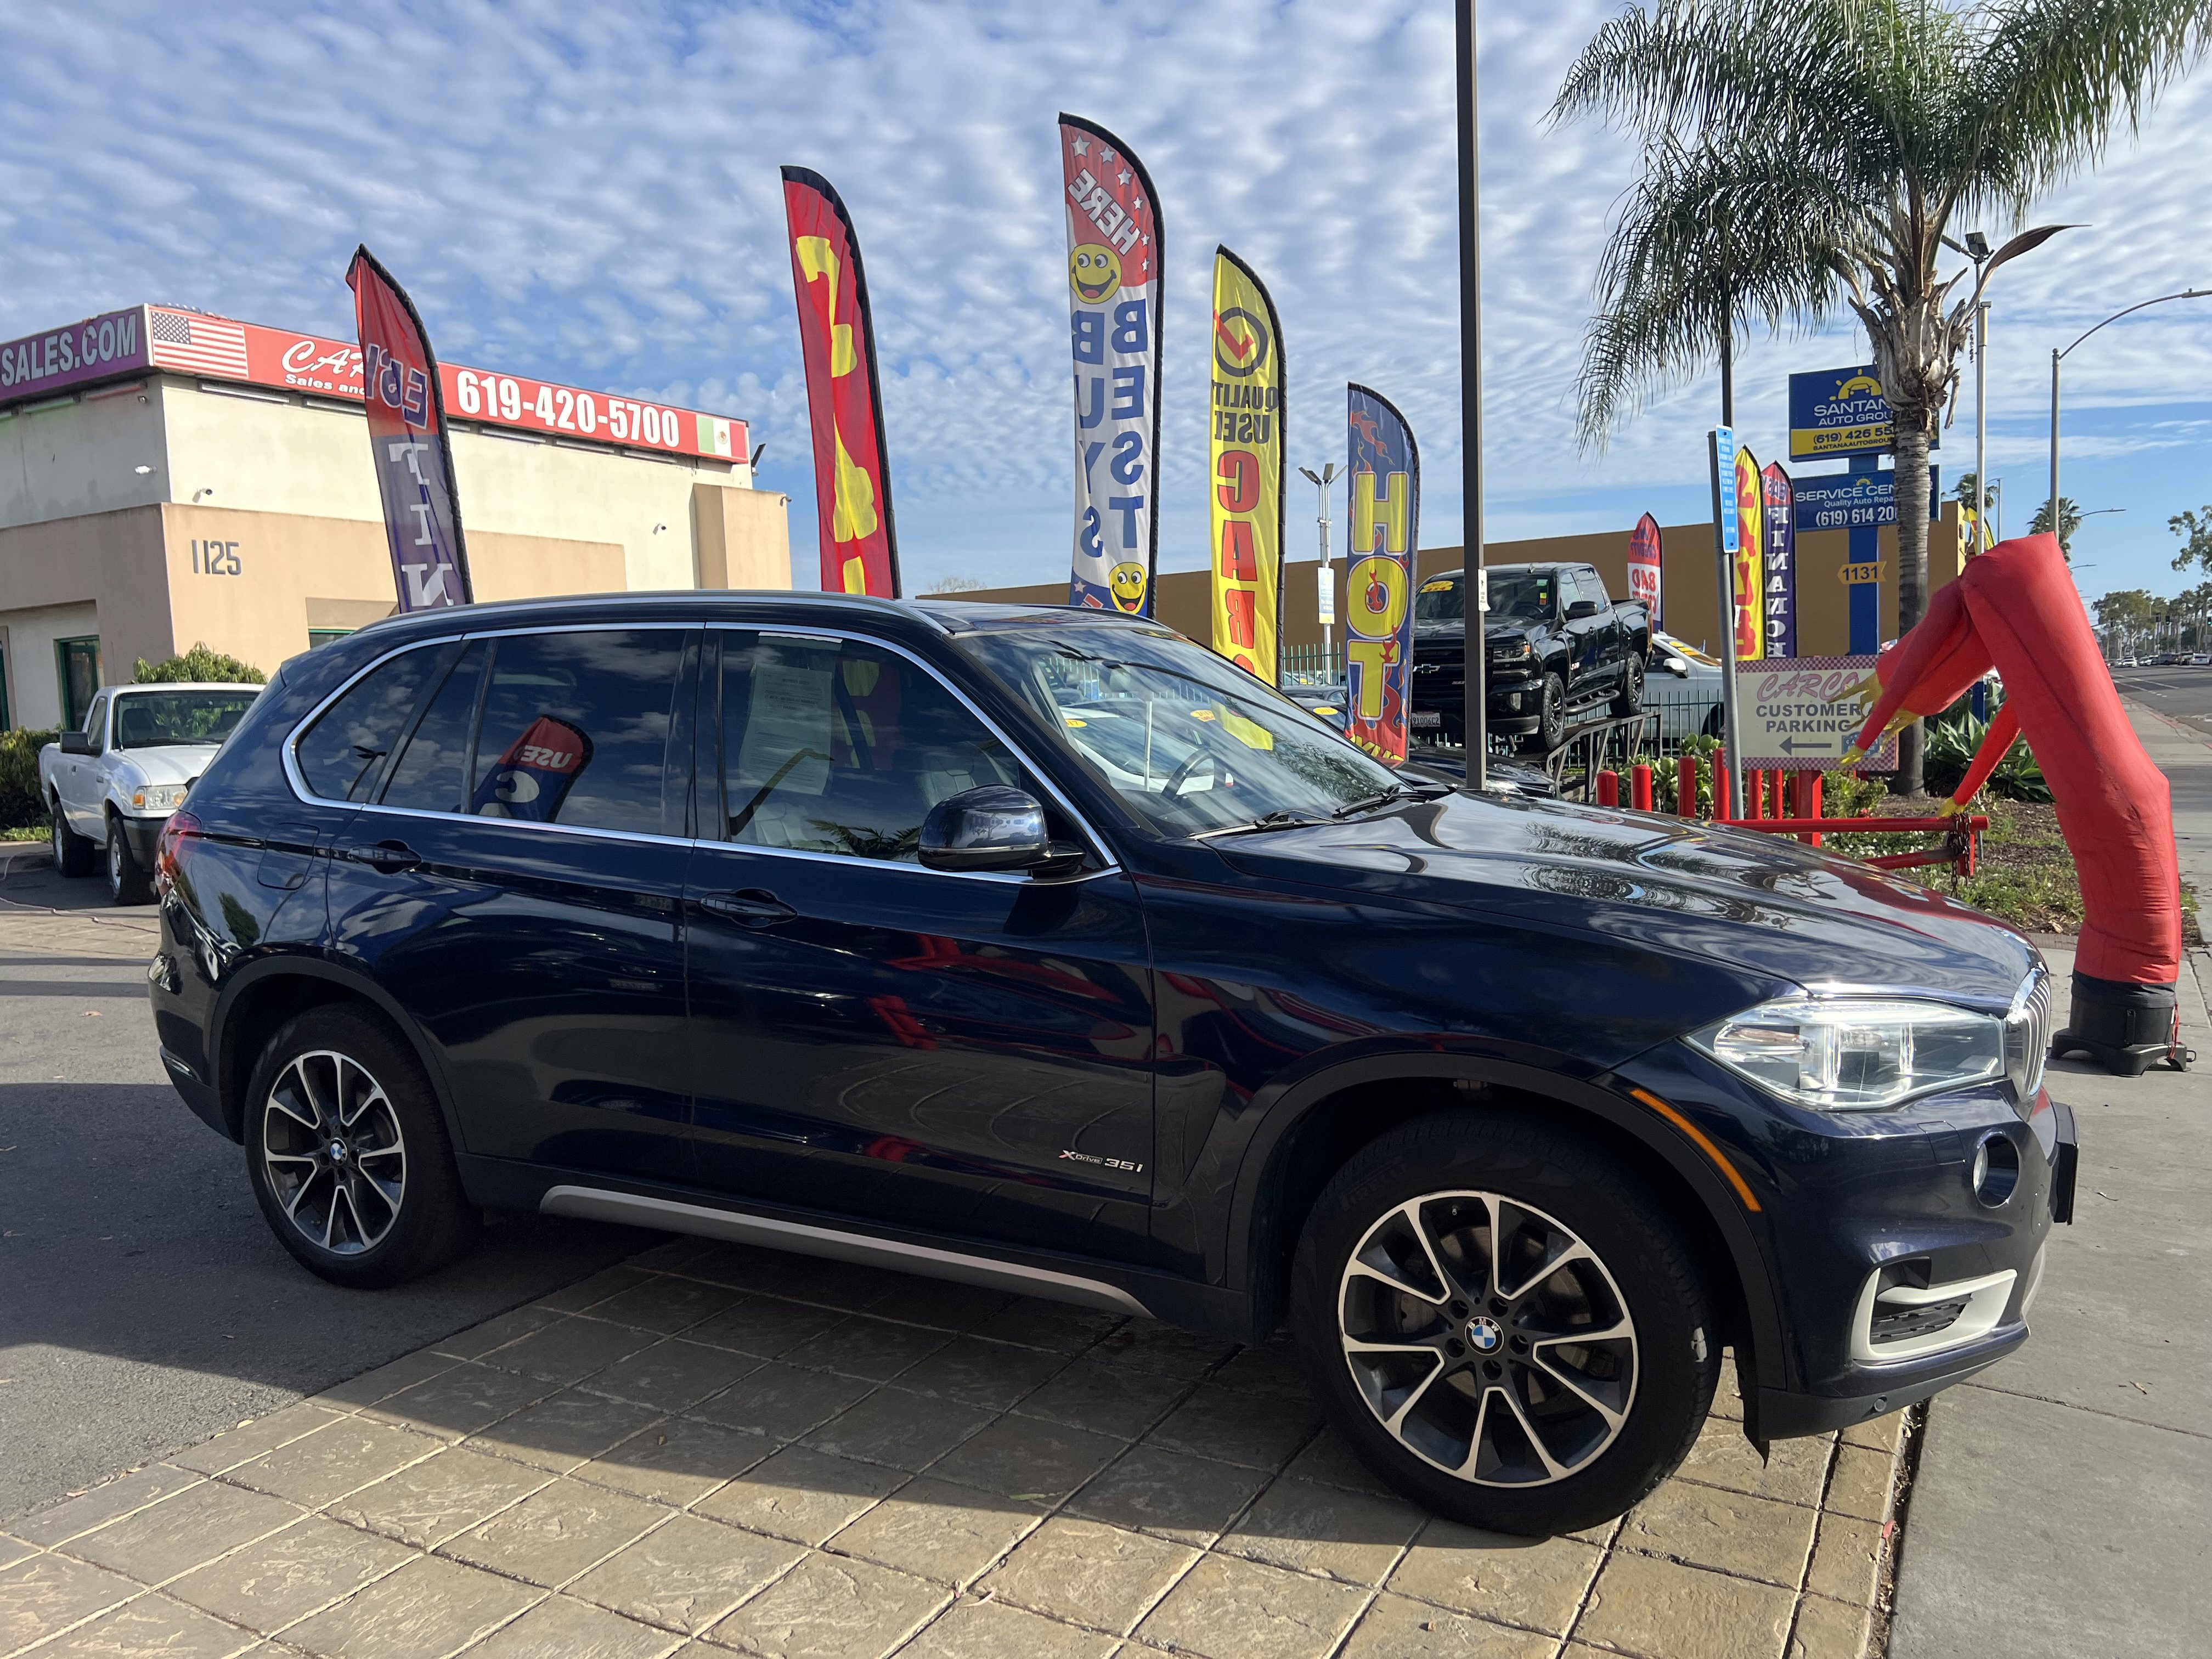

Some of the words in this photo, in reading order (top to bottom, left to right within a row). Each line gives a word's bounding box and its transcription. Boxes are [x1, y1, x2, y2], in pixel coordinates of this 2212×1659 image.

[2, 314, 137, 386] SALES.COM
[285, 374, 333, 390] Sales
[457, 370, 679, 448] 619-420-5700
[1814, 399, 1891, 417] SANTAN
[1818, 415, 1854, 426] AUTO
[1856, 411, 1894, 422] GROU
[1813, 432, 1842, 445] (619)
[1846, 429, 1871, 439] 426
[1875, 427, 1893, 436] 55
[1796, 487, 1862, 501] SERVICE
[1866, 484, 1896, 495] CEN
[1824, 499, 1852, 508] Quality
[1875, 495, 1894, 504] Repa
[1815, 509, 1848, 527] (619)
[1852, 507, 1874, 524] 614
[191, 539, 242, 575] 1125
[1842, 566, 1877, 580] 1131
[1346, 471, 1410, 721] HOT
[1757, 672, 1859, 702] CARCO
[1756, 703, 1861, 717] CUSTOMER
[1766, 720, 1850, 732] PARKING
[1468, 1317, 1499, 1332] BMW
